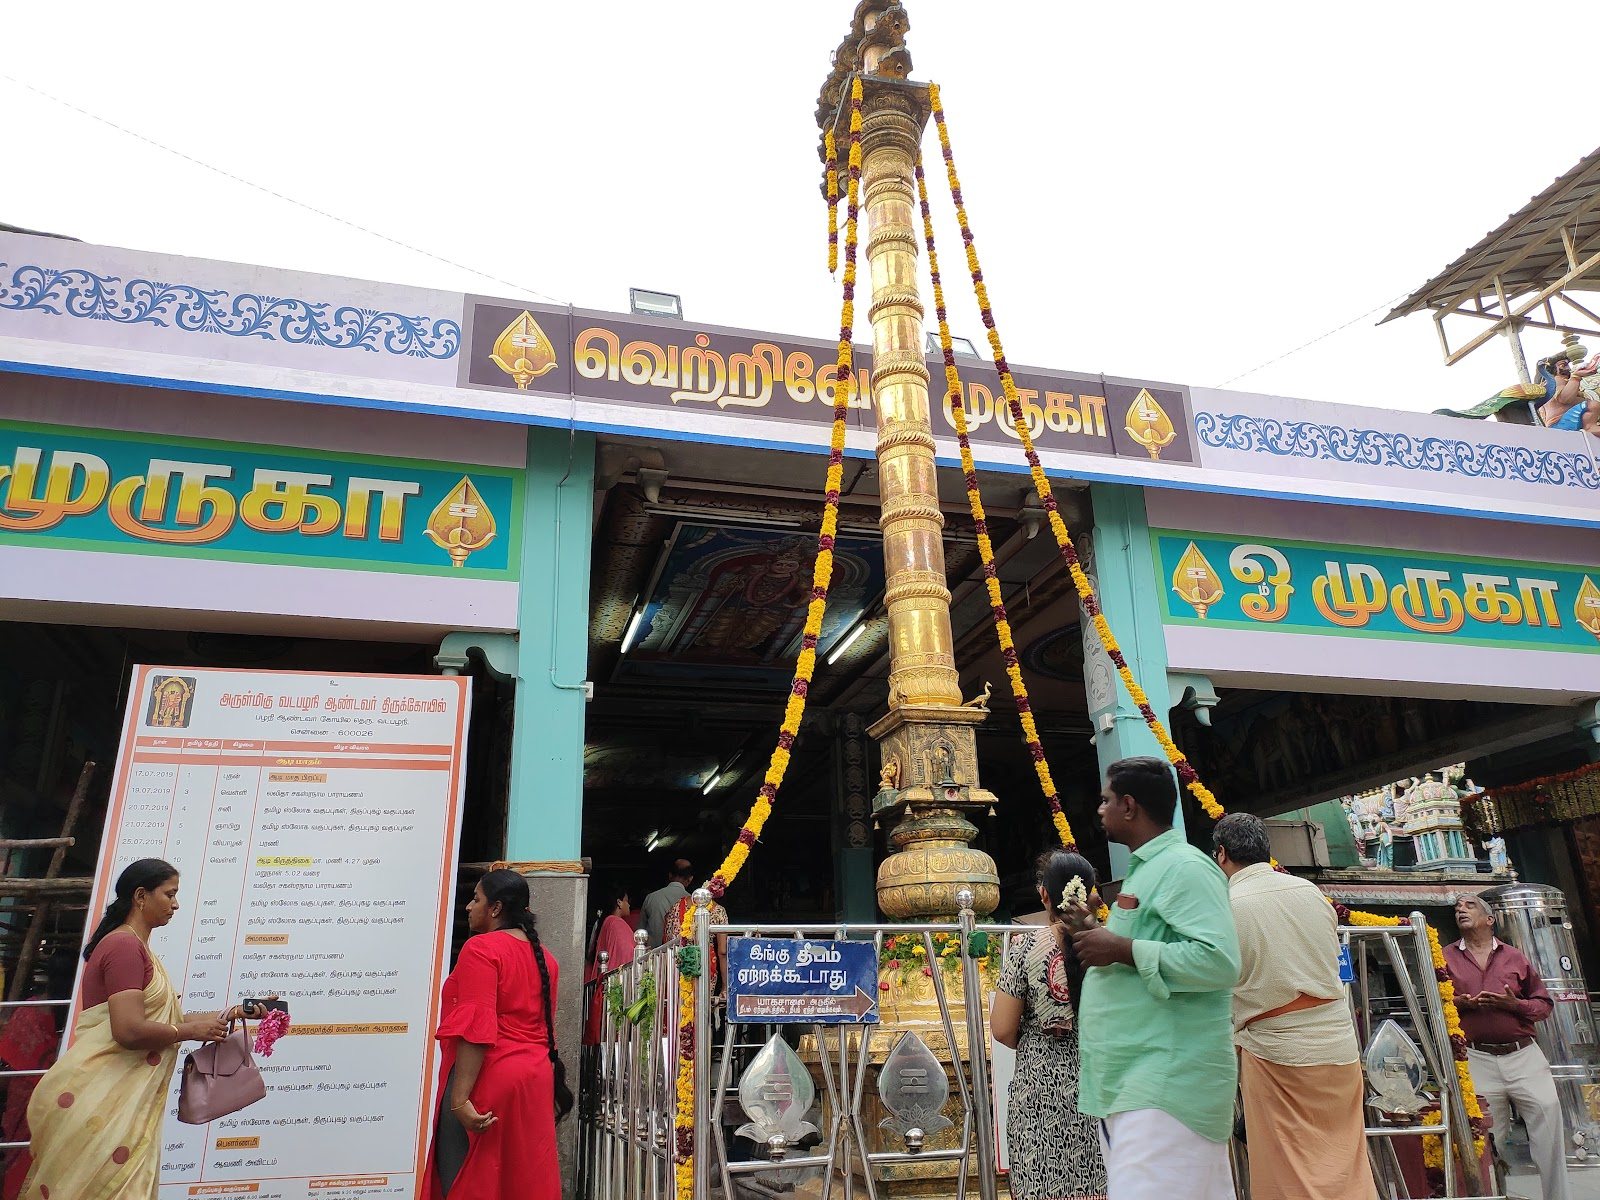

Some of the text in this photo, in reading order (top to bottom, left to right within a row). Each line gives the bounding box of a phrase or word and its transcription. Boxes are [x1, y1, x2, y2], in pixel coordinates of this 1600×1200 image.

[574, 327, 1107, 440] வெற்றிவே முருகா
[0, 446, 420, 544] முருகா
[1312, 560, 1560, 634] முருகா
[219, 690, 447, 713] அருள்மிகு வடபழநி ஆண்டவர் திருக்கோயில்
[131, 787, 171, 795] 19.07.2019
[128, 804, 169, 812] 20.07.2019
[121, 838, 163, 846] 25.07.2019
[749, 943, 790, 965] இங்கு
[1560, 955, 1573, 971] 8
